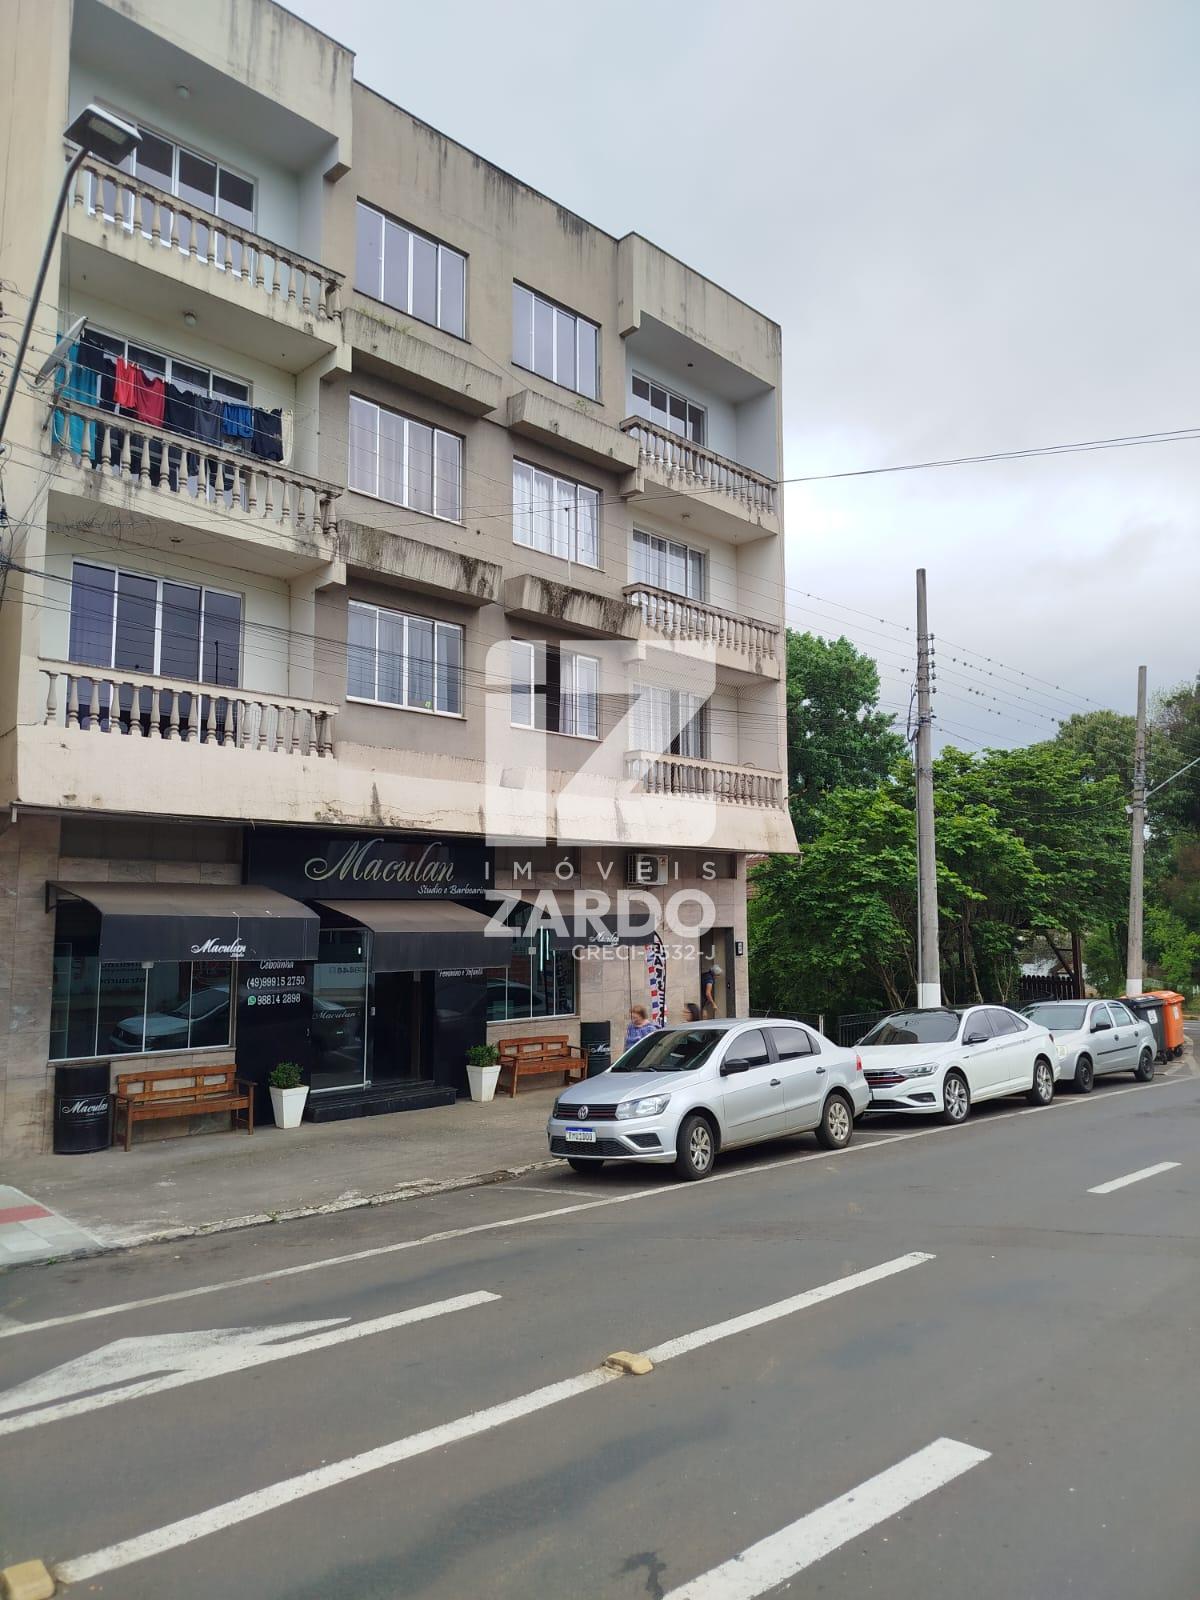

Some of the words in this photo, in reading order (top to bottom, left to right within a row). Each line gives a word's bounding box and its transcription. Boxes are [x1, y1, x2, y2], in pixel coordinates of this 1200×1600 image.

[304, 838, 454, 882] Maculan
[417, 883, 443, 894] Studio
[190, 937, 246, 954] Maculan
[286, 975, 306, 986] 2750
[257, 994, 281, 1006] 98814
